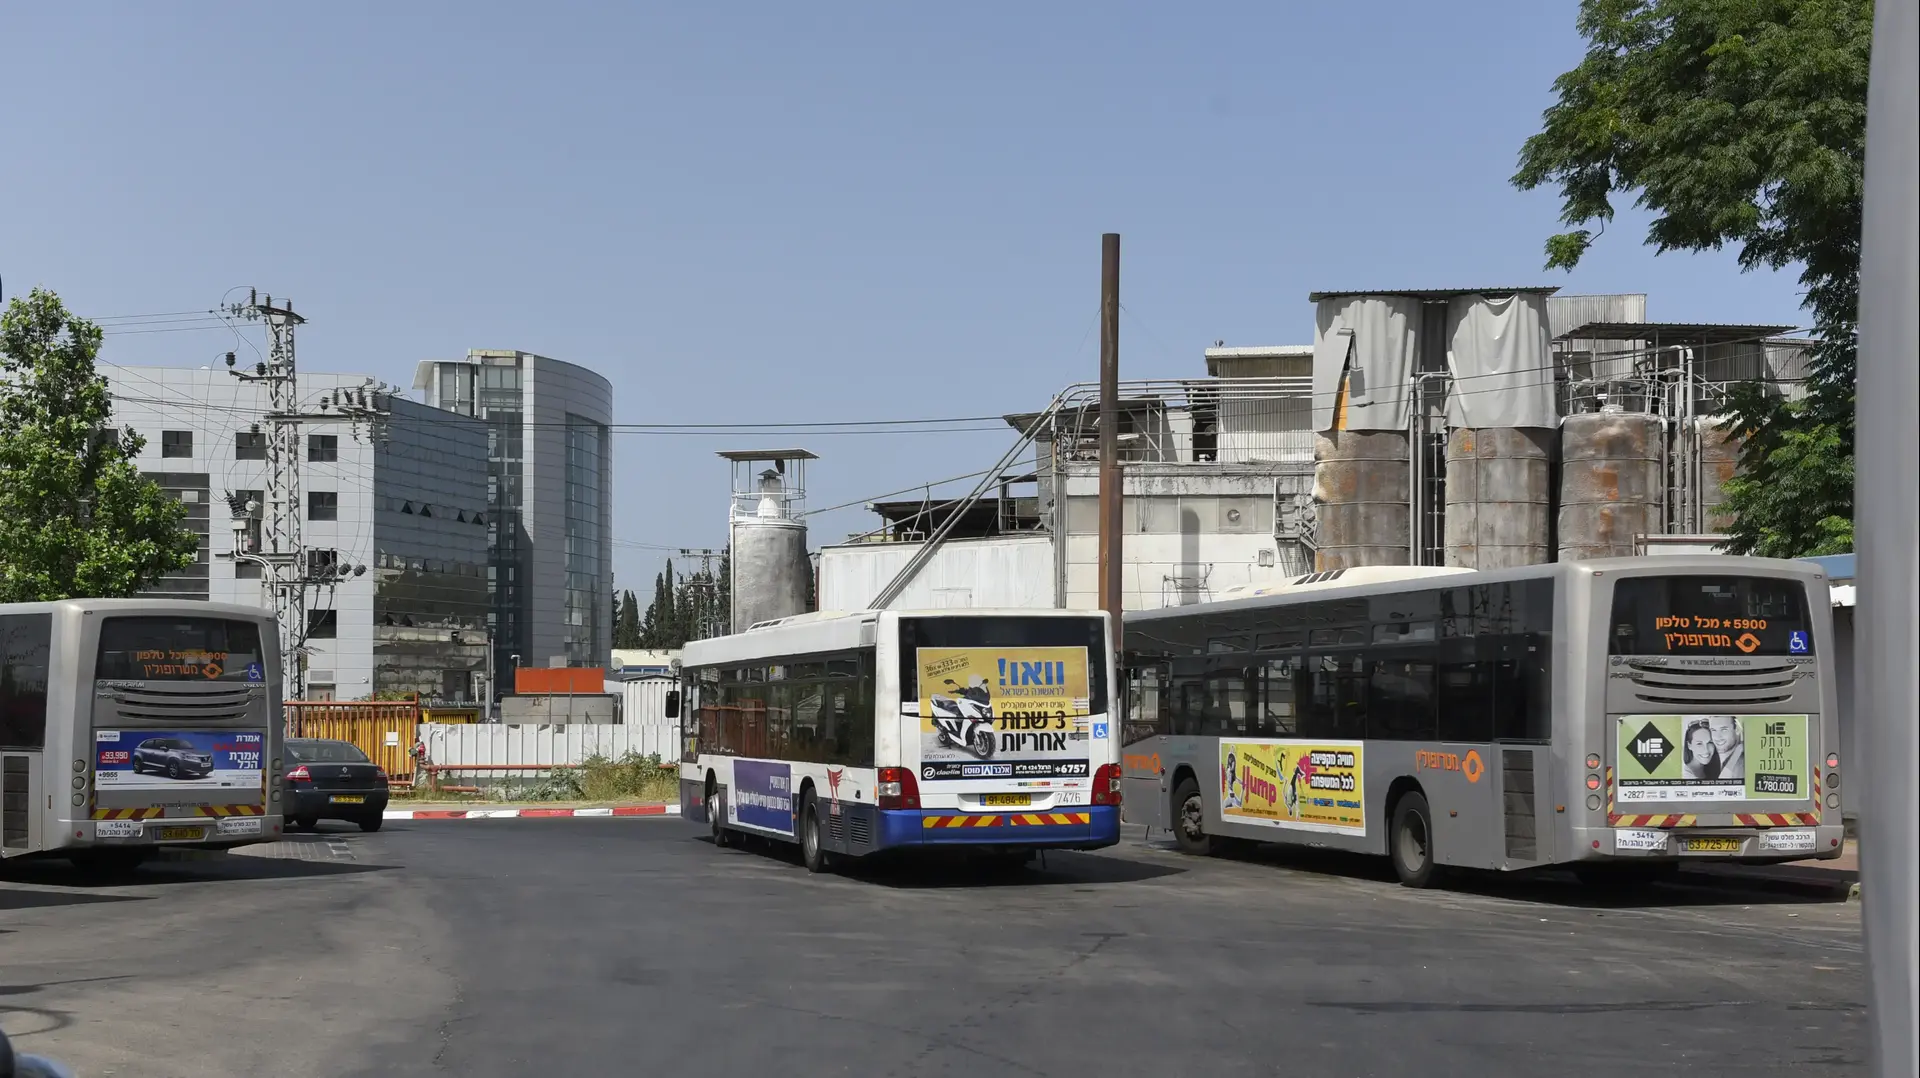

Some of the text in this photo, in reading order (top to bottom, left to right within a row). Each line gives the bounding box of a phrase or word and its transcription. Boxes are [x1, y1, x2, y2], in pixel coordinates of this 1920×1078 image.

[1656, 615, 1689, 630] טלפון
[1694, 615, 1720, 628] מכל
[1664, 633, 1731, 650] מטרופולין
[136, 650, 165, 662] טלפון
[1680, 658, 1751, 667] www.merkavim.com
[144, 663, 199, 679] מטרופולין
[997, 658, 1065, 686] וואו!
[1000, 686, 1065, 696] לראשונה בישראל
[1000, 701, 1027, 710] ומקבלים
[1049, 700, 1066, 709] קונים
[1000, 710, 1066, 730] 3 שנות
[1766, 722, 1786, 735] ME
[1000, 732, 1067, 752] אחריות
[1637, 738, 1663, 754] ME
[1760, 736, 1791, 749] מרתק
[229, 752, 259, 760] אמרת
[1769, 748, 1784, 758] את
[237, 759, 258, 769] הכל
[1311, 752, 1354, 769] חוויה מקפיצה
[1415, 749, 1460, 775] מטרופולין
[1760, 759, 1793, 771] רעננה
[993, 765, 1010, 774] אלבר
[1311, 775, 1354, 790] לכל המשפחה
[1057, 792, 1081, 803] 7476
[1765, 834, 1779, 842] עשן?
